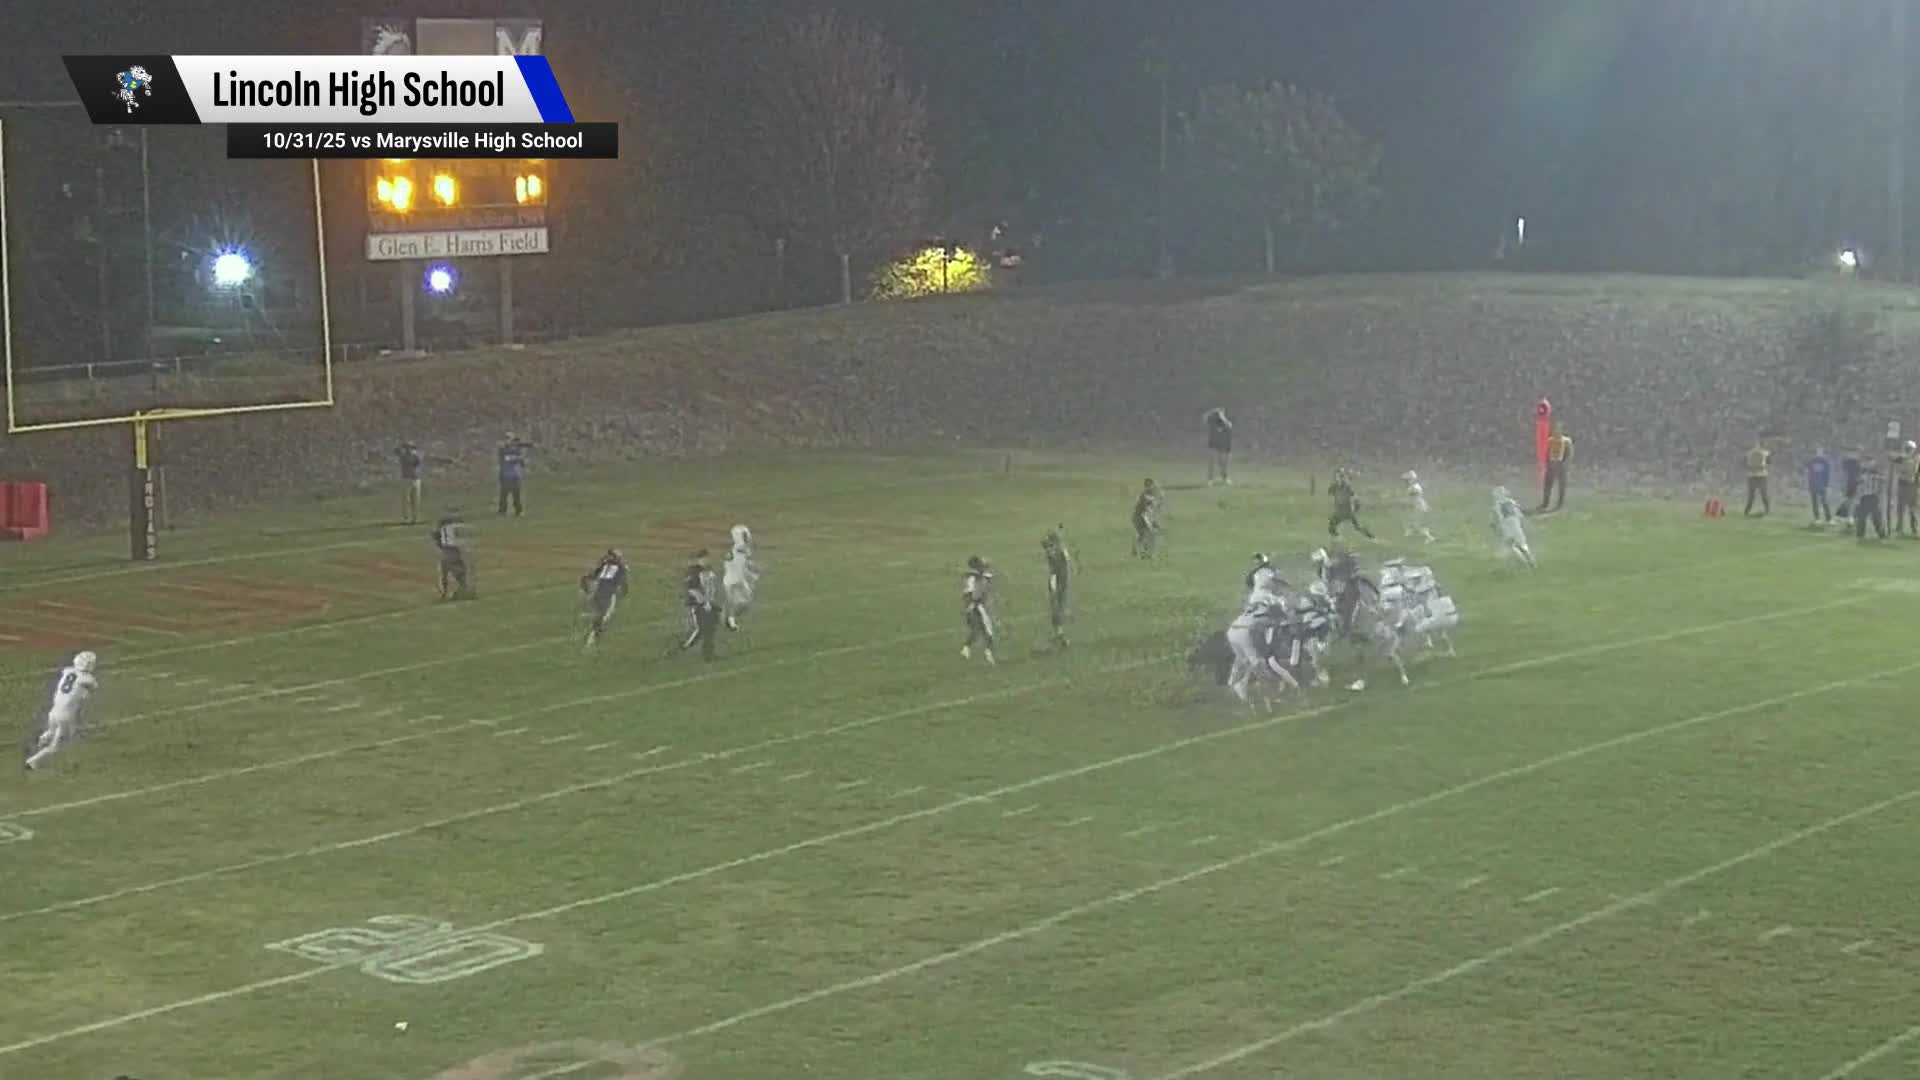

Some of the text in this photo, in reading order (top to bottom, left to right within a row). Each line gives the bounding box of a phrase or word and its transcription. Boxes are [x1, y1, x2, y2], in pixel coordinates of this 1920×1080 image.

[378, 238, 417, 256] Glen
[447, 233, 494, 253] Harris
[499, 231, 539, 251] Field
[61, 673, 77, 694] 8
